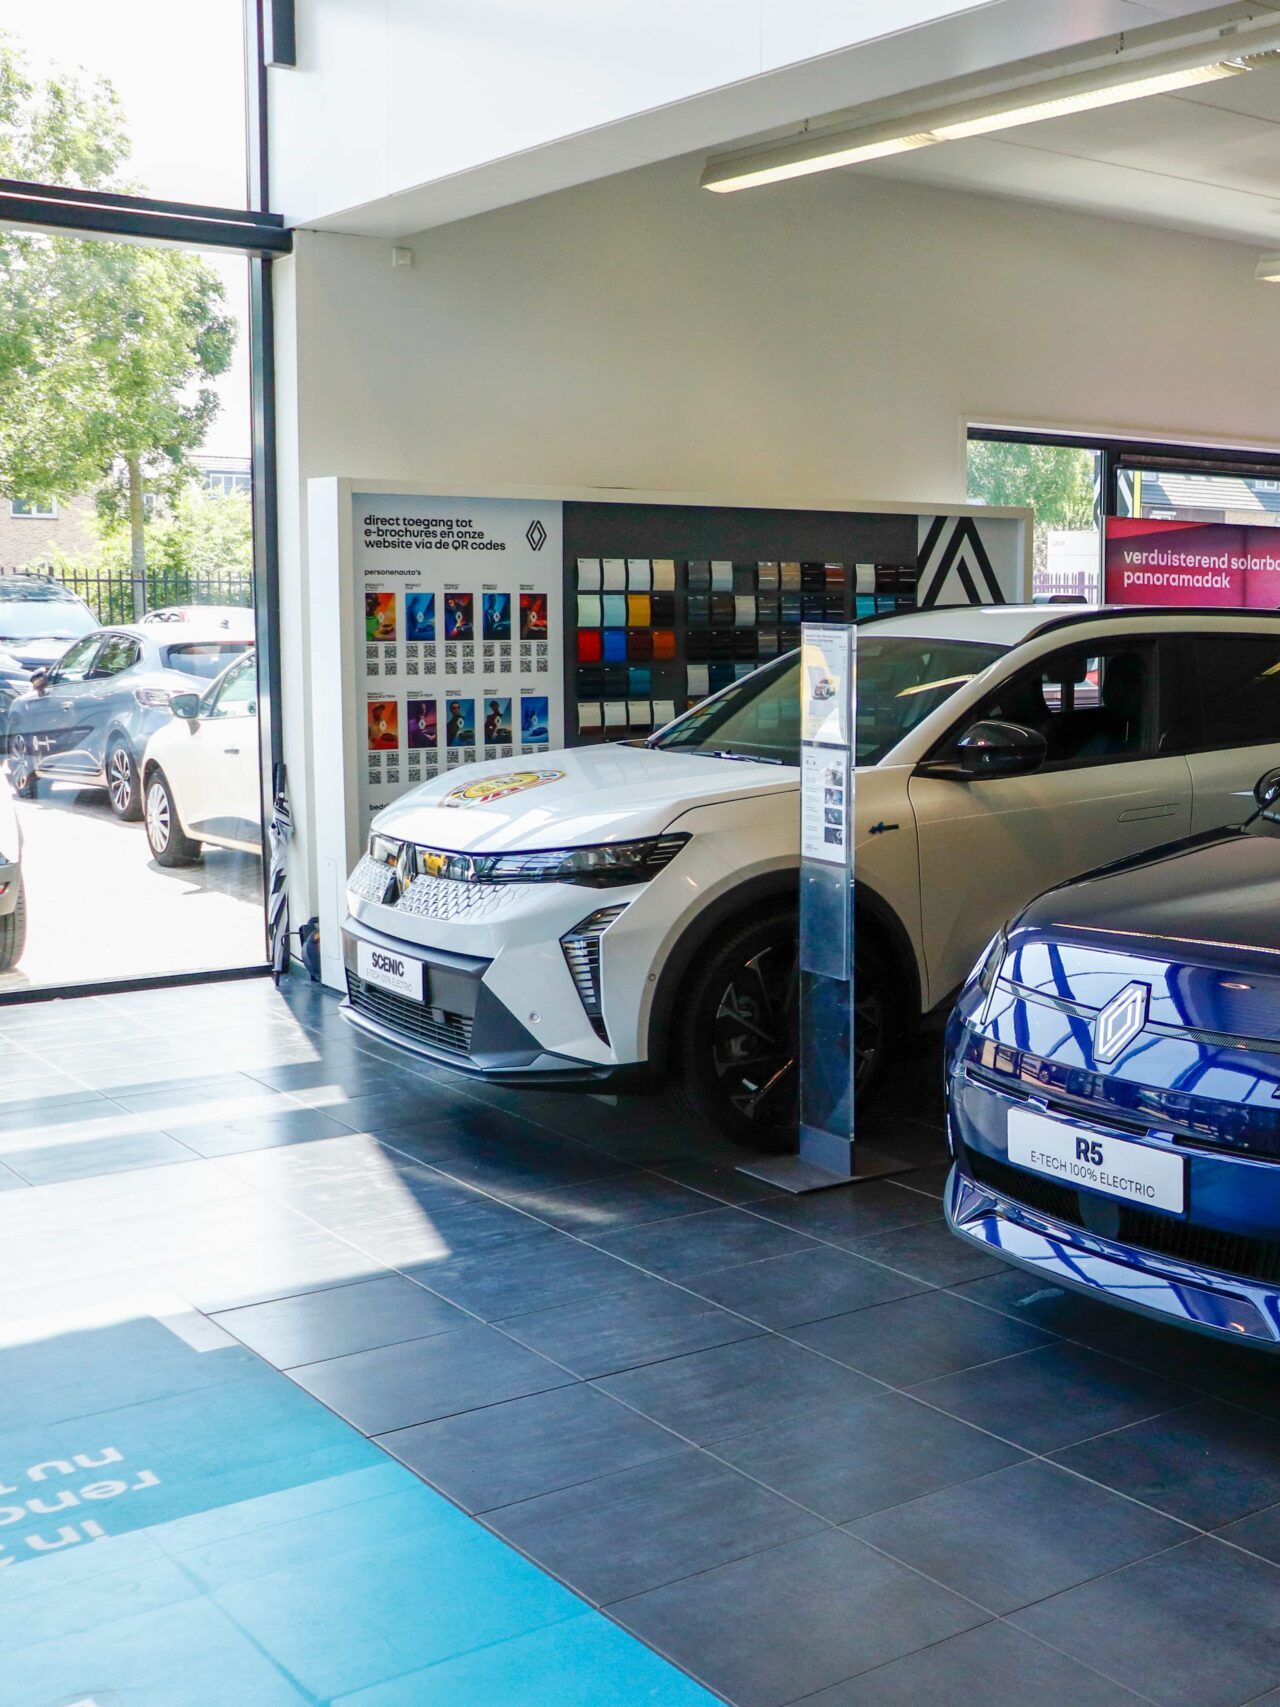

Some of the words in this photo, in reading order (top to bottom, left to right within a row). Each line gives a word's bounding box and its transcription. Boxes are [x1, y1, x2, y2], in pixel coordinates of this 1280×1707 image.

[364, 515, 400, 527] direct
[402, 516, 453, 530] toegang
[455, 518, 473, 528] tot
[364, 527, 438, 538] e-brochures
[439, 529, 455, 539] en
[456, 530, 485, 540] onze
[364, 538, 413, 549] website
[414, 539, 433, 549] via
[434, 540, 450, 550] de
[451, 540, 469, 551] QR
[471, 540, 506, 551] codes
[1123, 549, 1229, 569] verduisterend
[364, 568, 422, 576] personenauto's
[1123, 571, 1231, 588] panoramadak
[372, 951, 405, 977] SCENIC
[1075, 1136, 1104, 1166] R5
[1030, 1150, 1067, 1173] E-TECH
[1069, 1162, 1098, 1182] 100%
[1099, 1172, 1155, 1198] ELECTRIC
